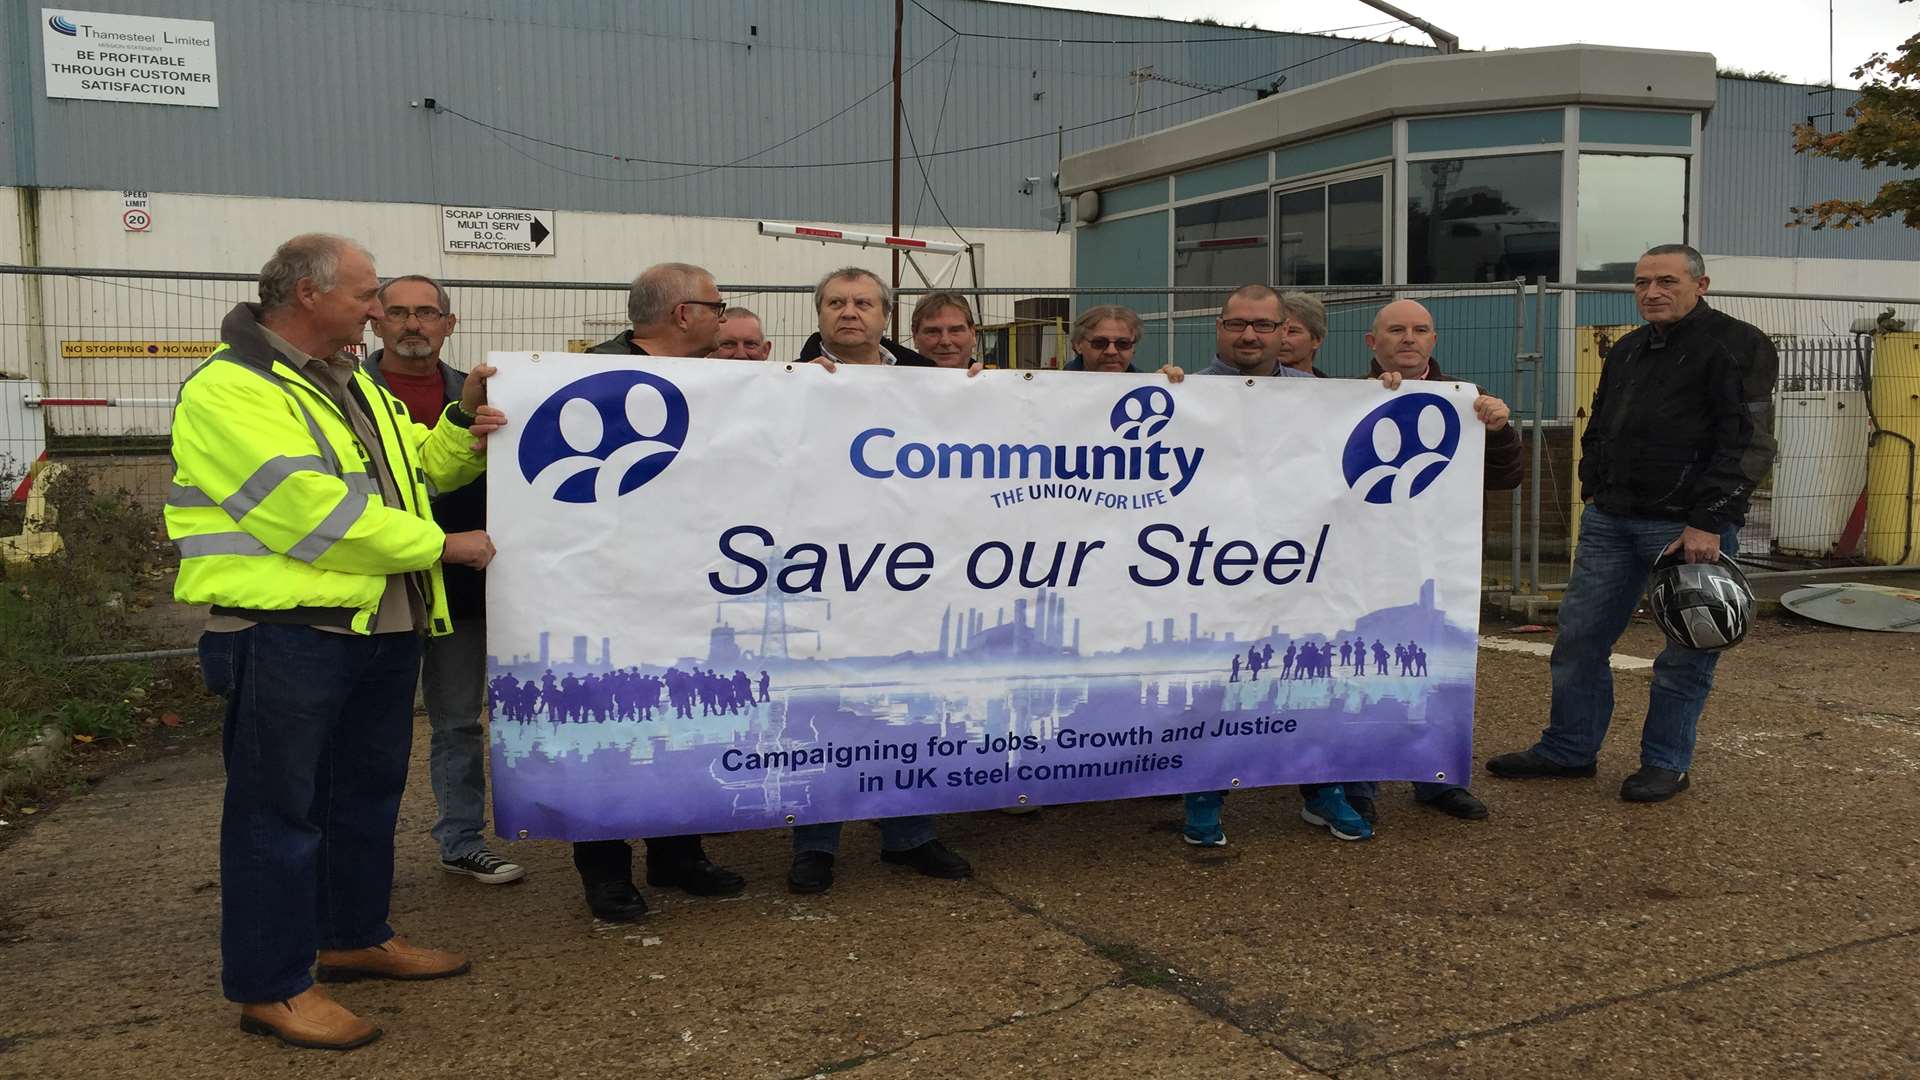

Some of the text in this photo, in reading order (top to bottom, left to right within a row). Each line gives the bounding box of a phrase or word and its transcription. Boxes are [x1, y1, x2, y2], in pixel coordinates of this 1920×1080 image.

[80, 25, 210, 47] Thamesteel Limited
[77, 50, 185, 67] BE PROFITABLE
[52, 63, 211, 83] THROUGH CUSTOMER
[81, 80, 185, 95] SATISFACTION
[123, 190, 148, 198] SPEED
[128, 215, 145, 224] 20
[446, 210, 532, 221] SCRAP LORRIES
[457, 221, 520, 231] MULTI SERV
[474, 231, 506, 240] B.O.C.
[449, 240, 531, 251] REFRACTORIES
[65, 345, 82, 353] NO
[86, 345, 144, 353] STOPPING
[163, 345, 179, 353] NO
[849, 427, 1205, 497] Community
[990, 483, 1168, 510] THE UNION FOR LIFE
[708, 522, 1331, 596] Save our Steel
[721, 716, 1298, 774] Campaigning for Jobs, Growth and Justice
[858, 751, 1184, 794] in UK steel communities
